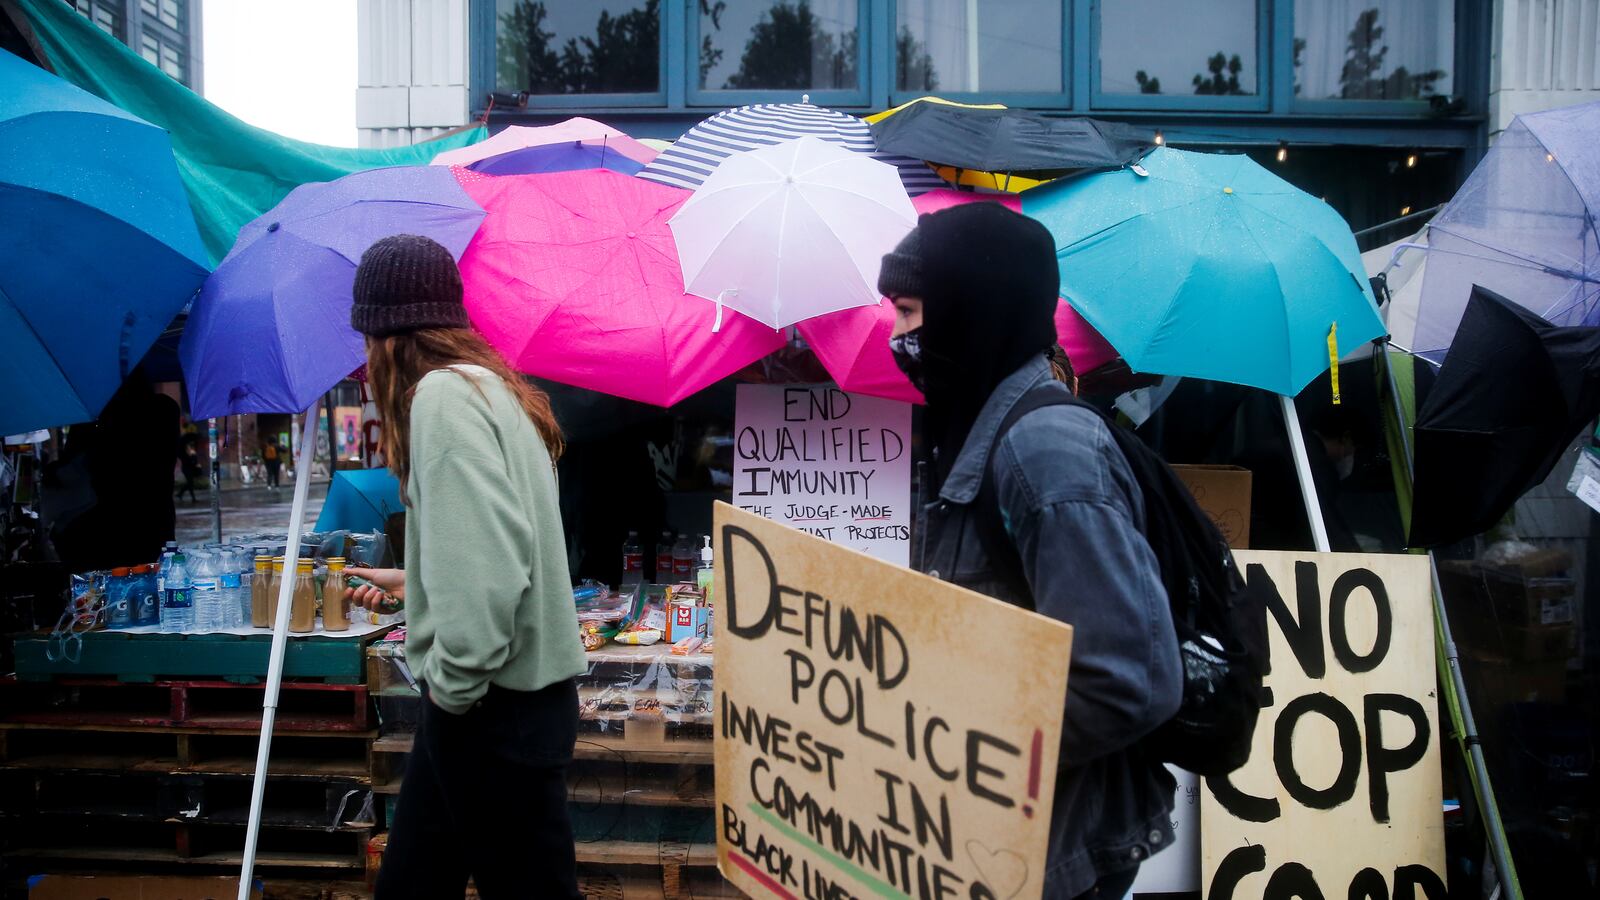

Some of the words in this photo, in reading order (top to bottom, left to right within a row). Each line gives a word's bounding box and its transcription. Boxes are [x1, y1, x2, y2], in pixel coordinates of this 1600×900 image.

[784, 388, 851, 422] END
[737, 427, 904, 463] QUALIFIED
[738, 467, 875, 499] IMMUNITY
[784, 504, 892, 521] JUDGE-MADE
[798, 527, 835, 541] AT
[844, 525, 910, 541] PROTECTS
[722, 524, 909, 690] DEFUND
[1246, 560, 1392, 680] NO
[784, 648, 1043, 819] POLICE!
[722, 691, 844, 790] INVEST
[875, 769, 954, 862] IN
[722, 803, 798, 887] BLACK
[802, 859, 859, 900] LIVE
